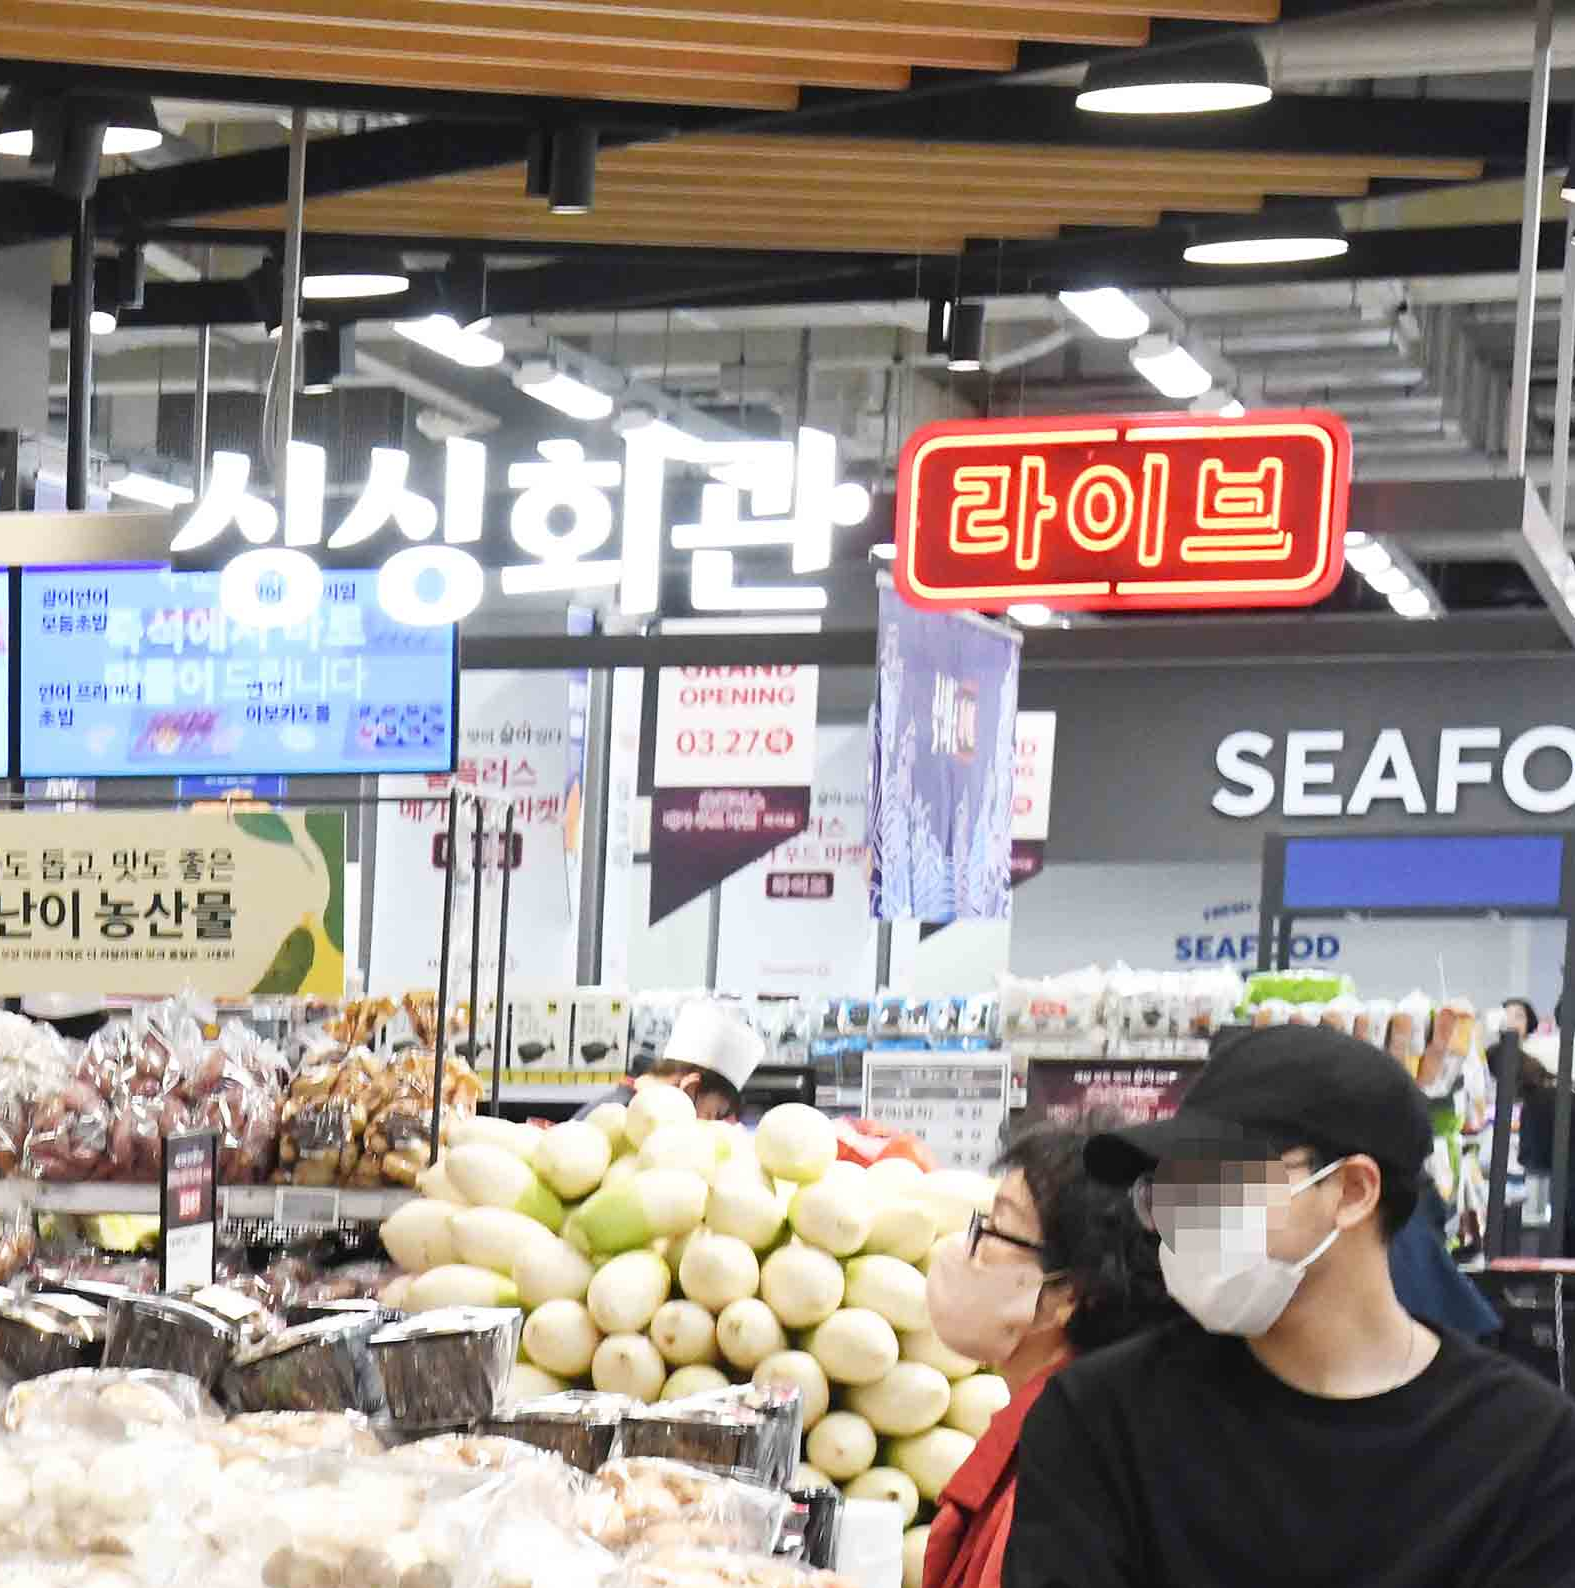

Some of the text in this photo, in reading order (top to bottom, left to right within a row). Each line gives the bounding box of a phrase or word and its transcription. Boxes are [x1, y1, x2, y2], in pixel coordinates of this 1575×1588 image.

[171, 424, 871, 628] 싱싱회관
[948, 450, 1294, 570] 라이브
[679, 686, 796, 705] OPENING
[1212, 725, 1575, 817] SEAFO
[41, 847, 102, 884] 돕고,
[111, 847, 169, 884] 맛도
[178, 847, 237, 884] 좋은
[94, 887, 237, 941] 농산물
[1176, 935, 1341, 961] SEAFOD
